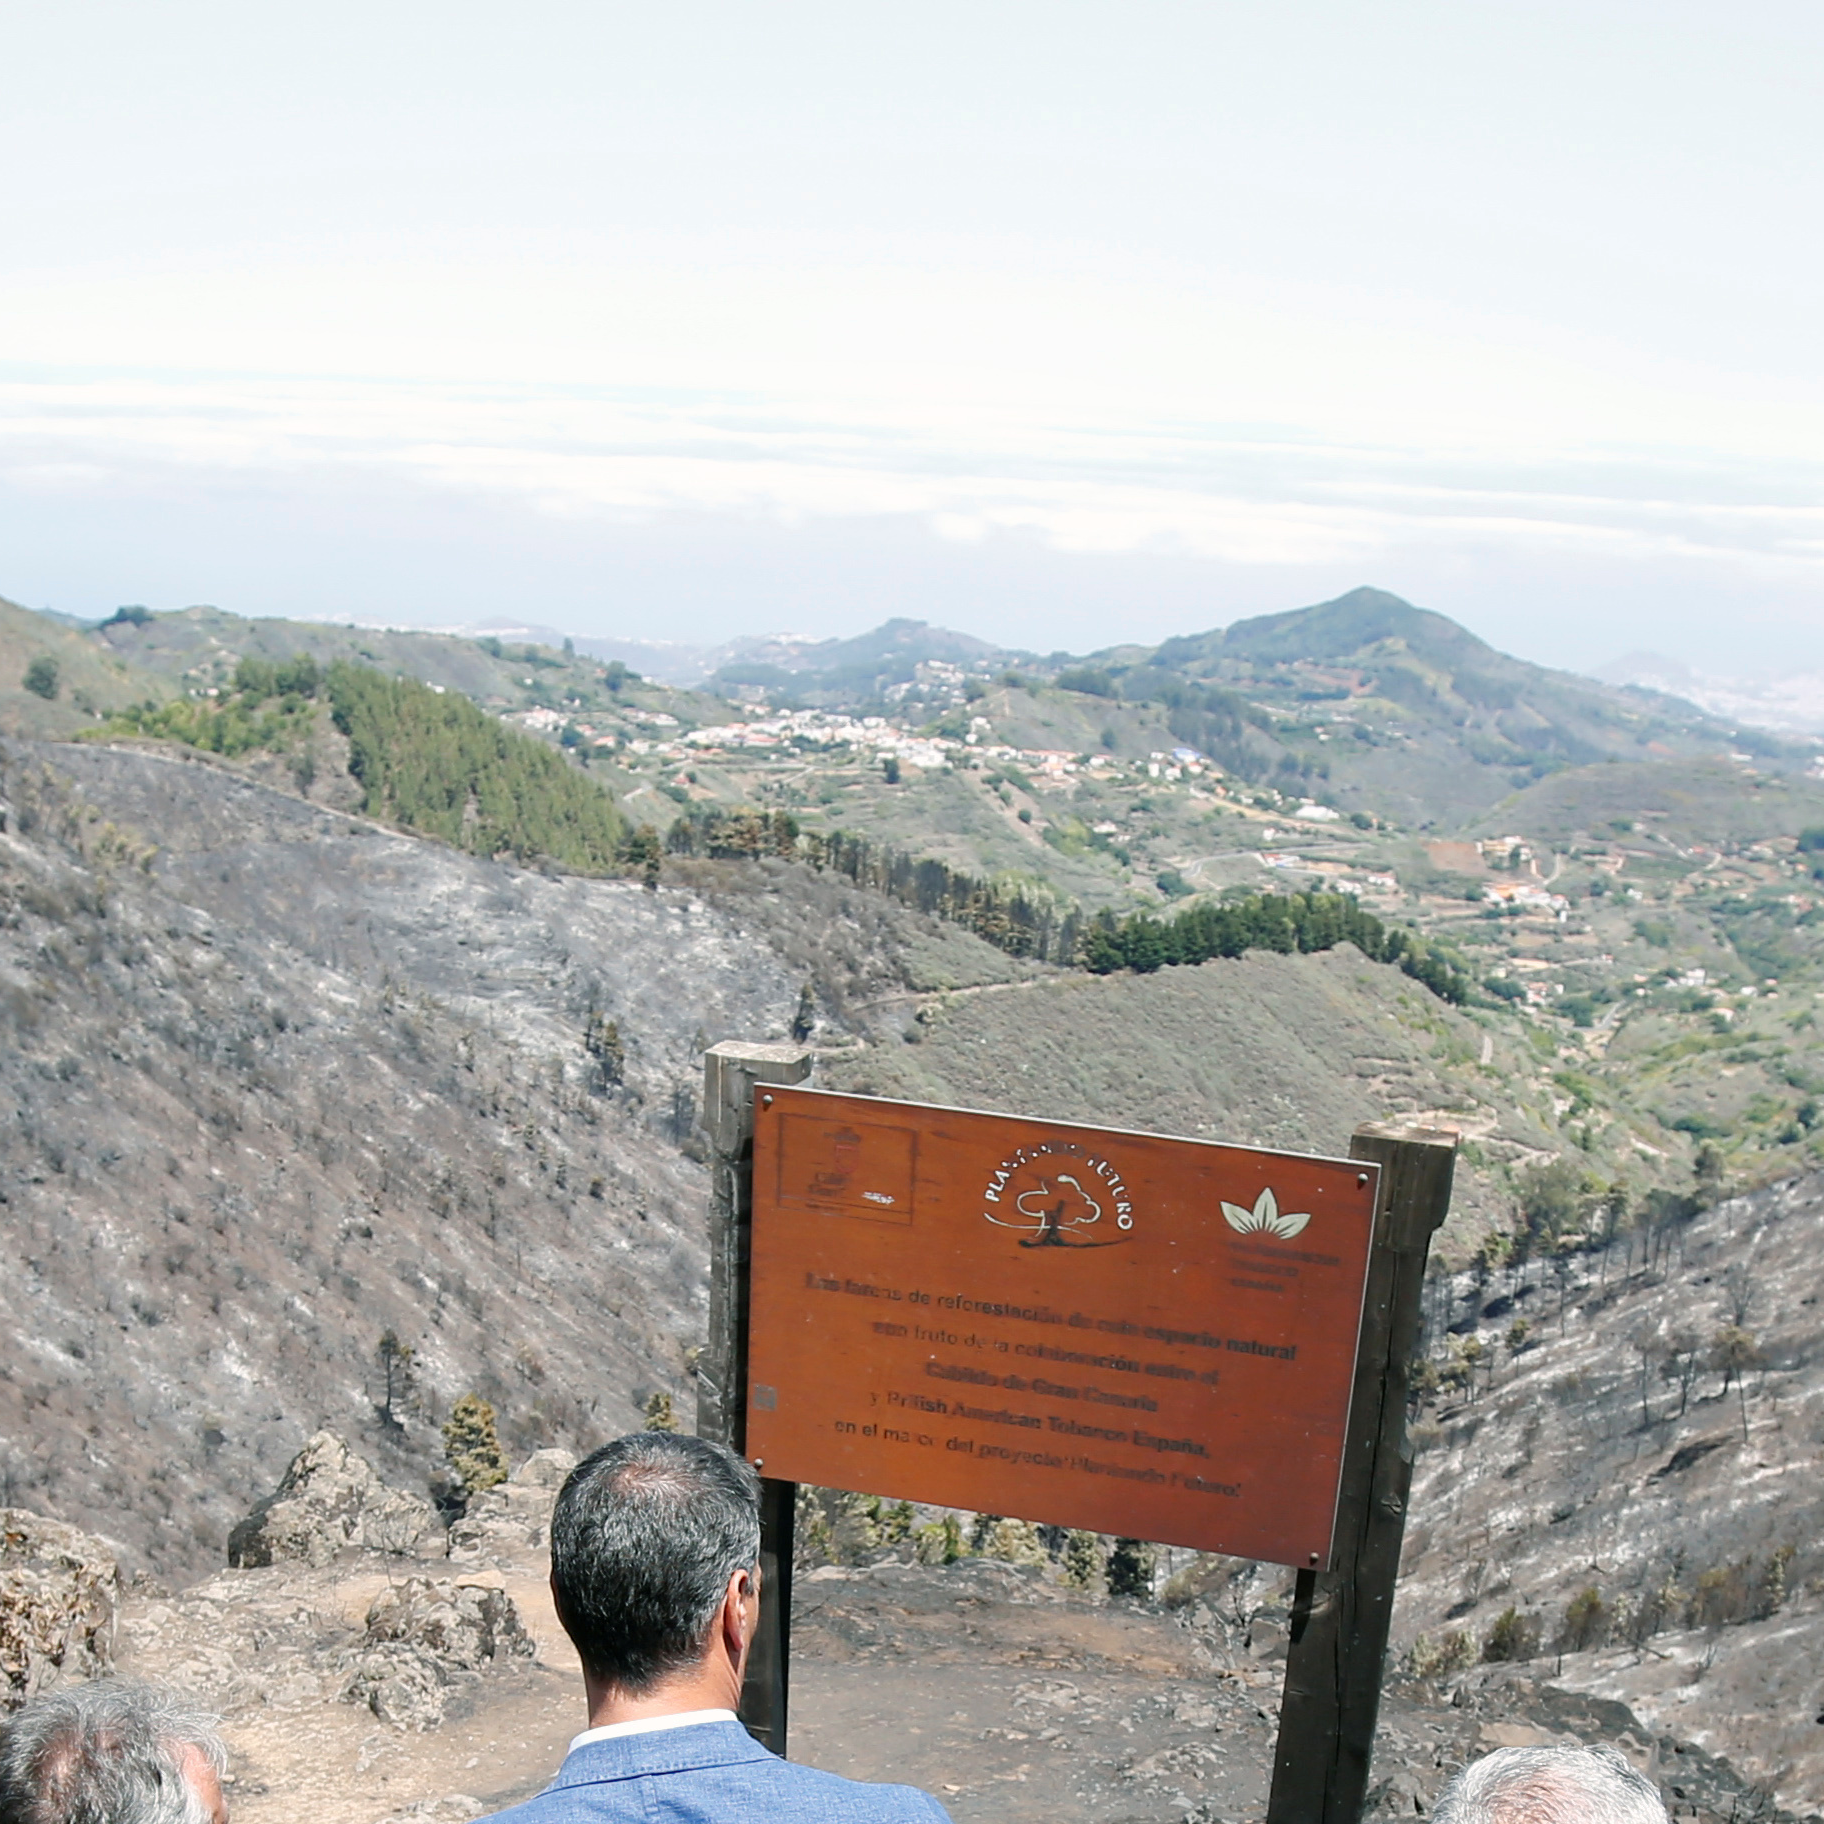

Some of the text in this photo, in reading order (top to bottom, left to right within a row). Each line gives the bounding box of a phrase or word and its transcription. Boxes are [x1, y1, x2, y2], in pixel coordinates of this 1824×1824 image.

[908, 1289, 930, 1305] de
[1225, 1335, 1297, 1360] natural
[834, 1419, 856, 1434] en
[862, 1422, 877, 1437] el
[945, 1435, 973, 1453] del
